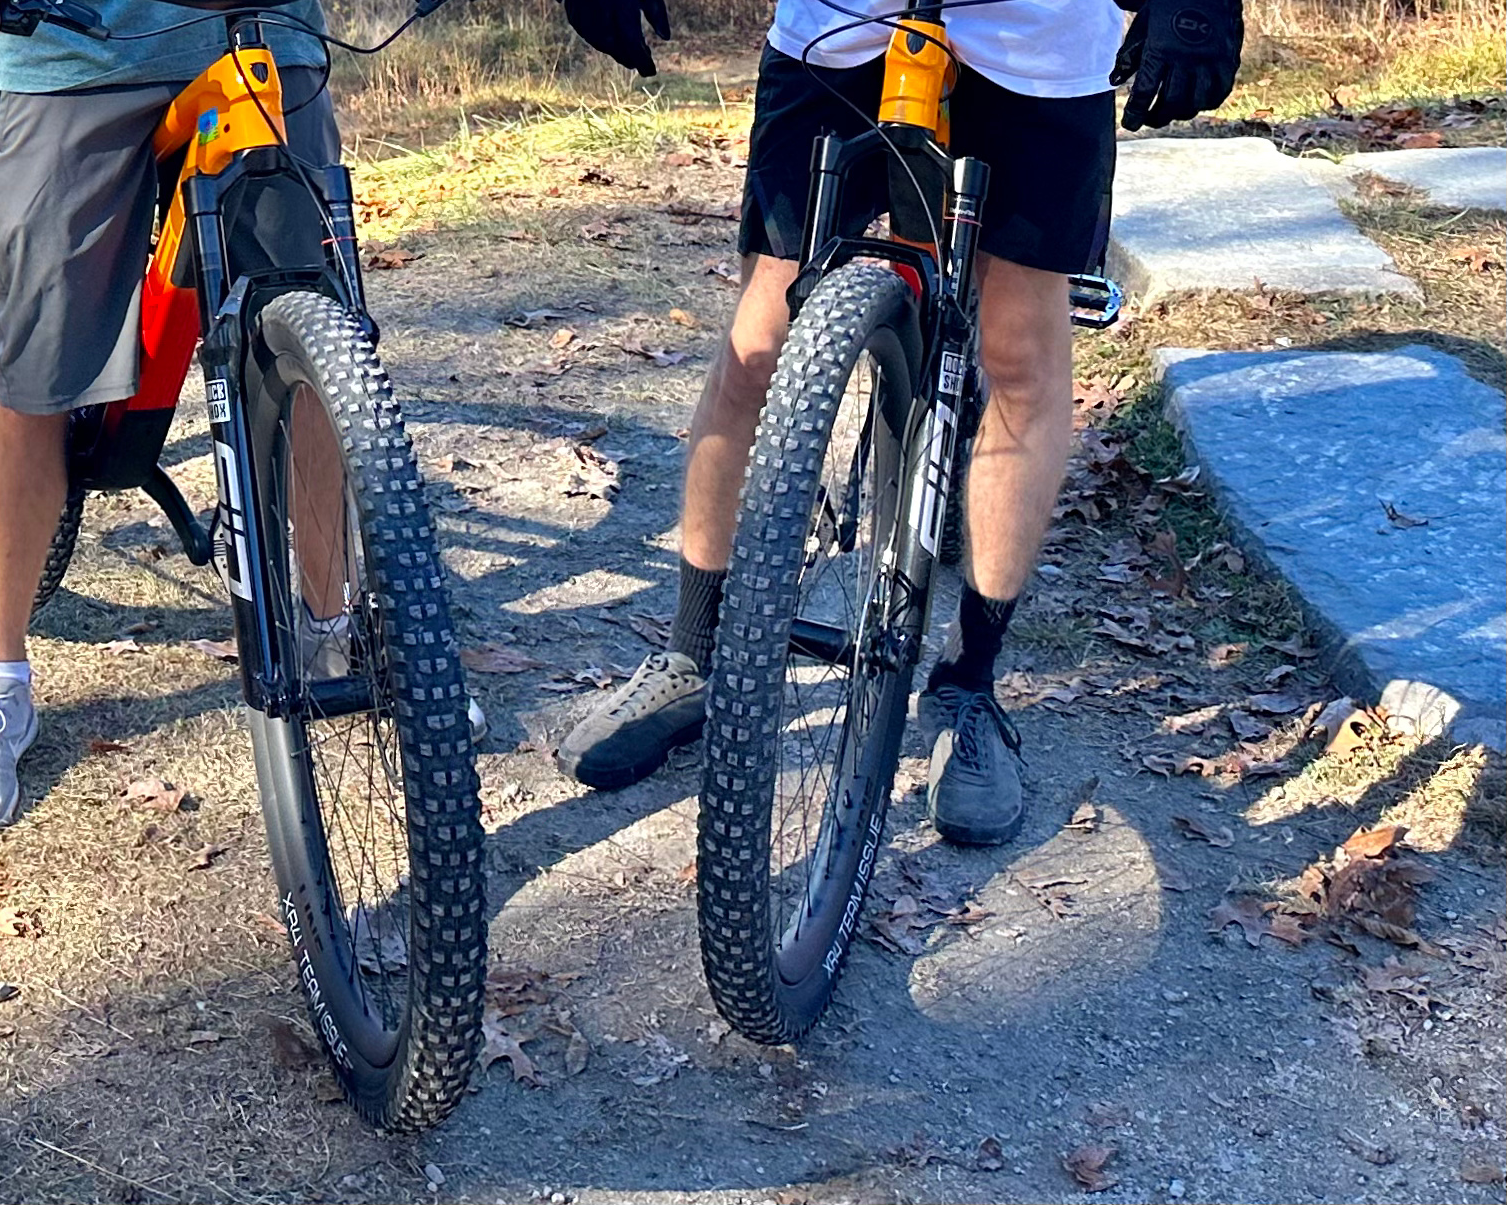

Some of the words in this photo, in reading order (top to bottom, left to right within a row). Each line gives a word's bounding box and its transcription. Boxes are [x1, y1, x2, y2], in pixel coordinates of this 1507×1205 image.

[282, 891, 302, 946] XR4
[299, 949, 326, 1017] TEAM
[319, 1012, 348, 1065] ISSUE
[822, 942, 842, 979] XR4
[839, 881, 863, 941] TEAM
[857, 813, 883, 885] ISSUE
